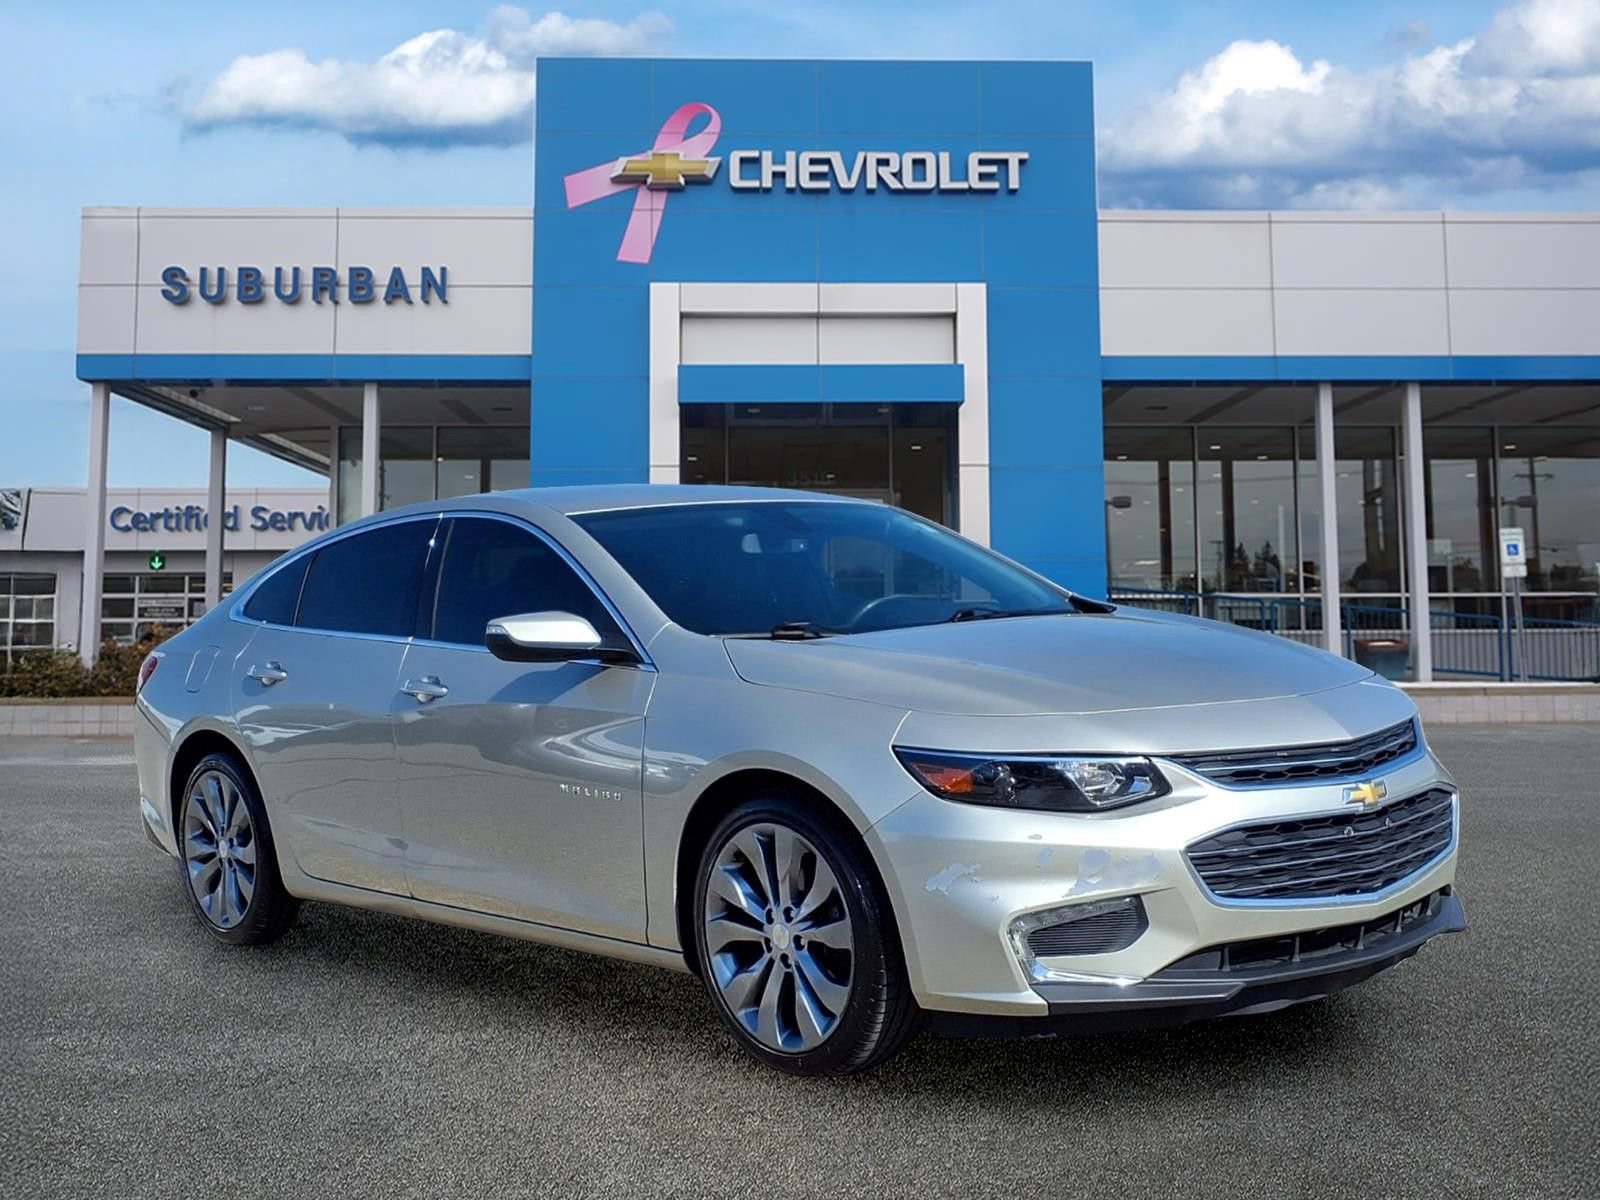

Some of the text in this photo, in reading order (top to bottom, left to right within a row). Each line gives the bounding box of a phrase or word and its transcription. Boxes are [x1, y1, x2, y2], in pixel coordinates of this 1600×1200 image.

[728, 150, 1029, 192] CHEVROLET
[161, 265, 448, 306] SUBURBAN
[110, 506, 241, 533] Certifid
